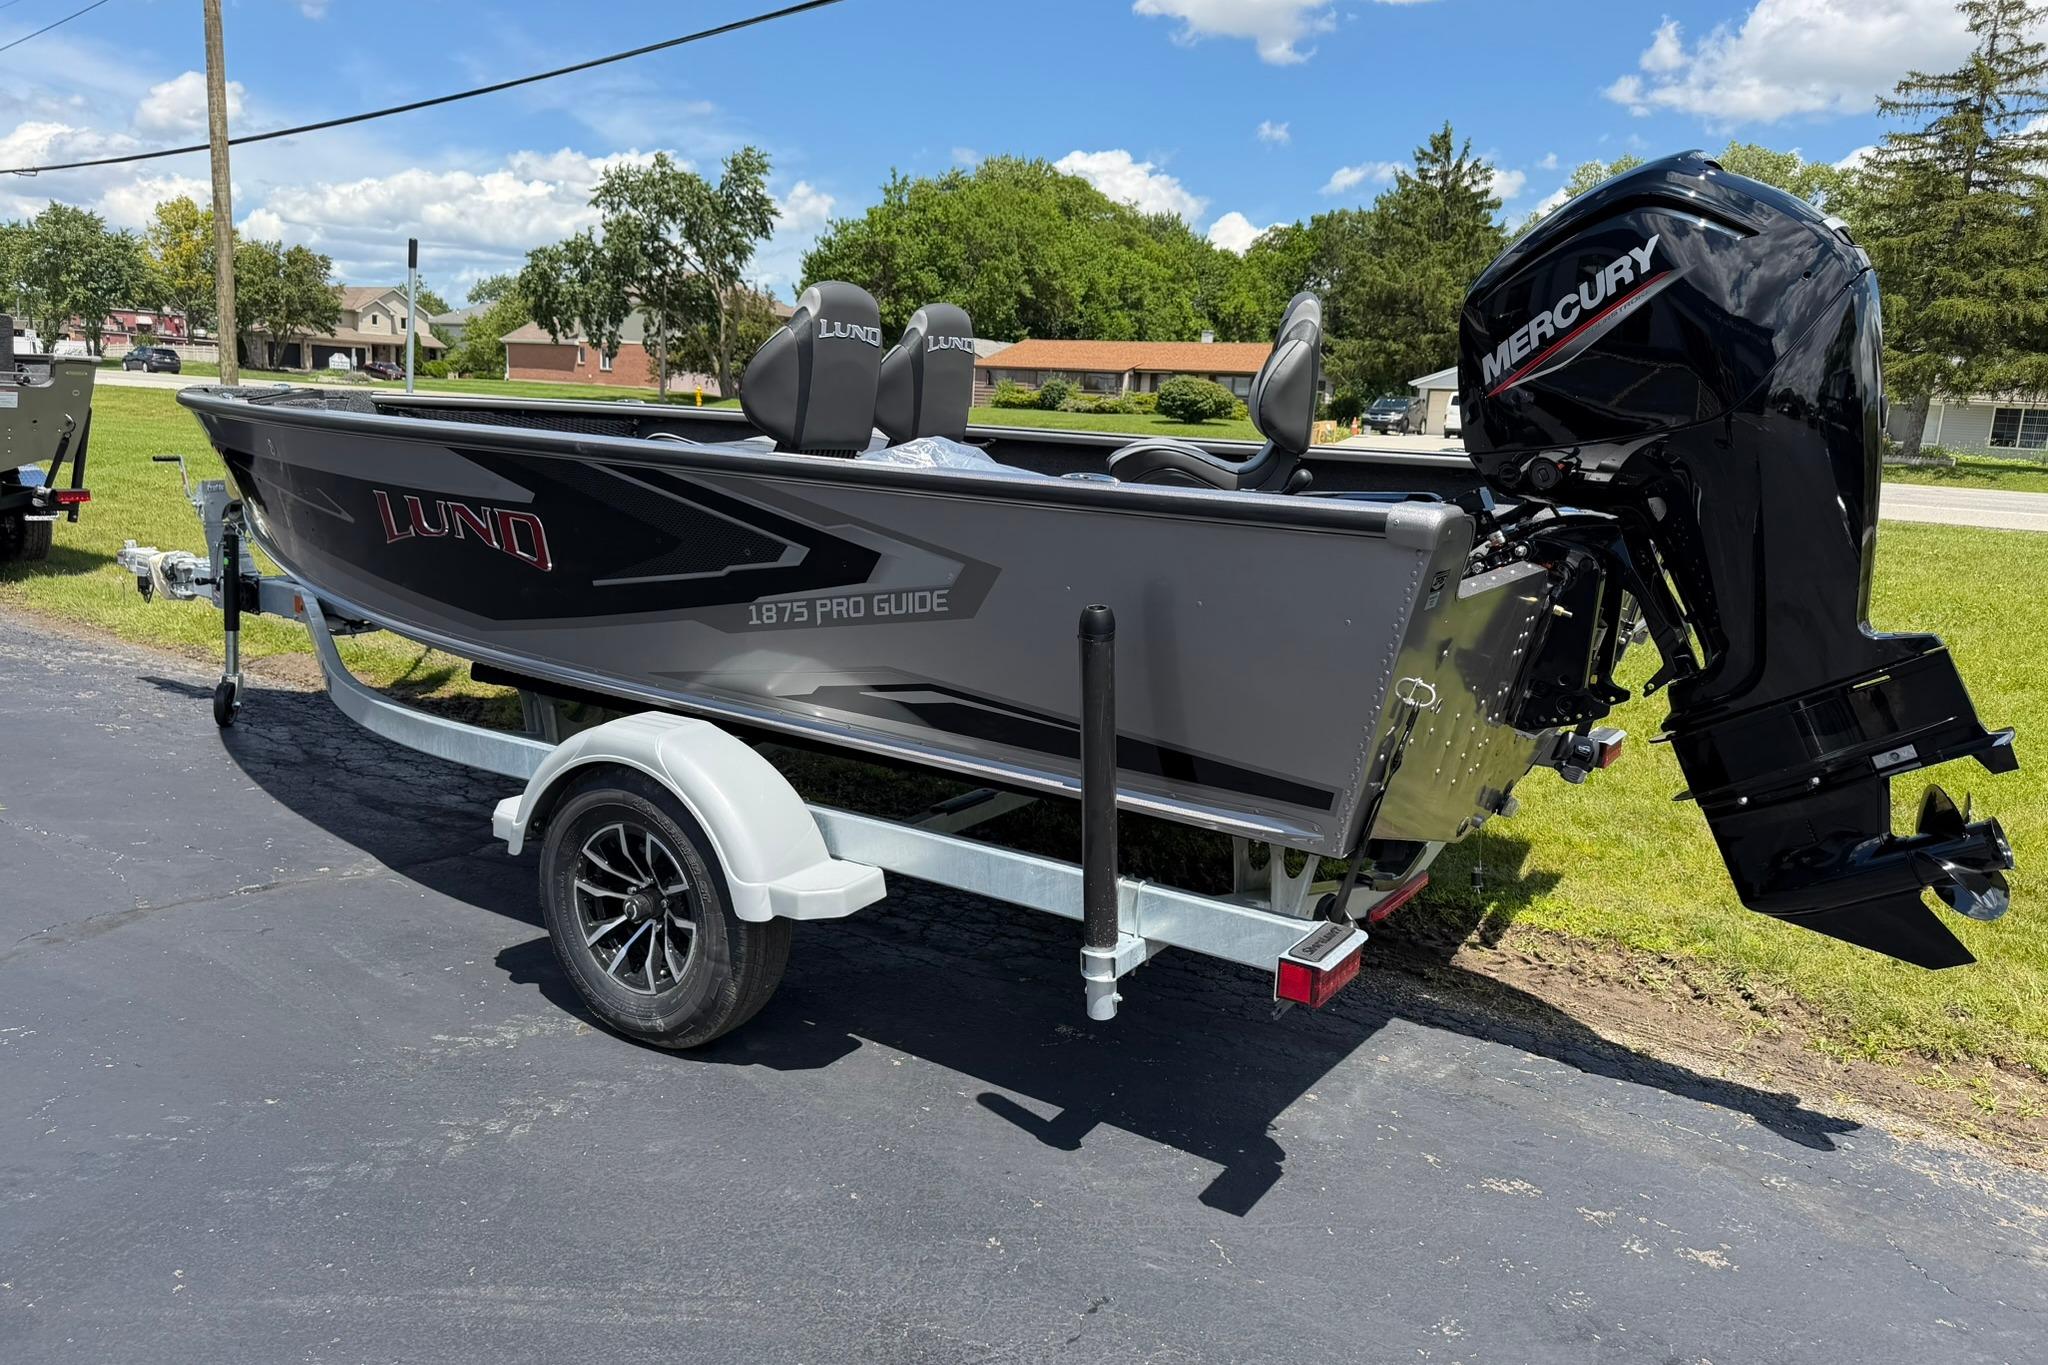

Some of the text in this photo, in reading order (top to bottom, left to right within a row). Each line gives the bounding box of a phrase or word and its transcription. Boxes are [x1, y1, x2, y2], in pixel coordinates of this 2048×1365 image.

[1481, 234, 1660, 386] MERCURY
[818, 318, 882, 347] LUND
[927, 335, 975, 354] LUND
[373, 489, 552, 572] LUND
[748, 590, 949, 626] 1875 PRO GUIDE
